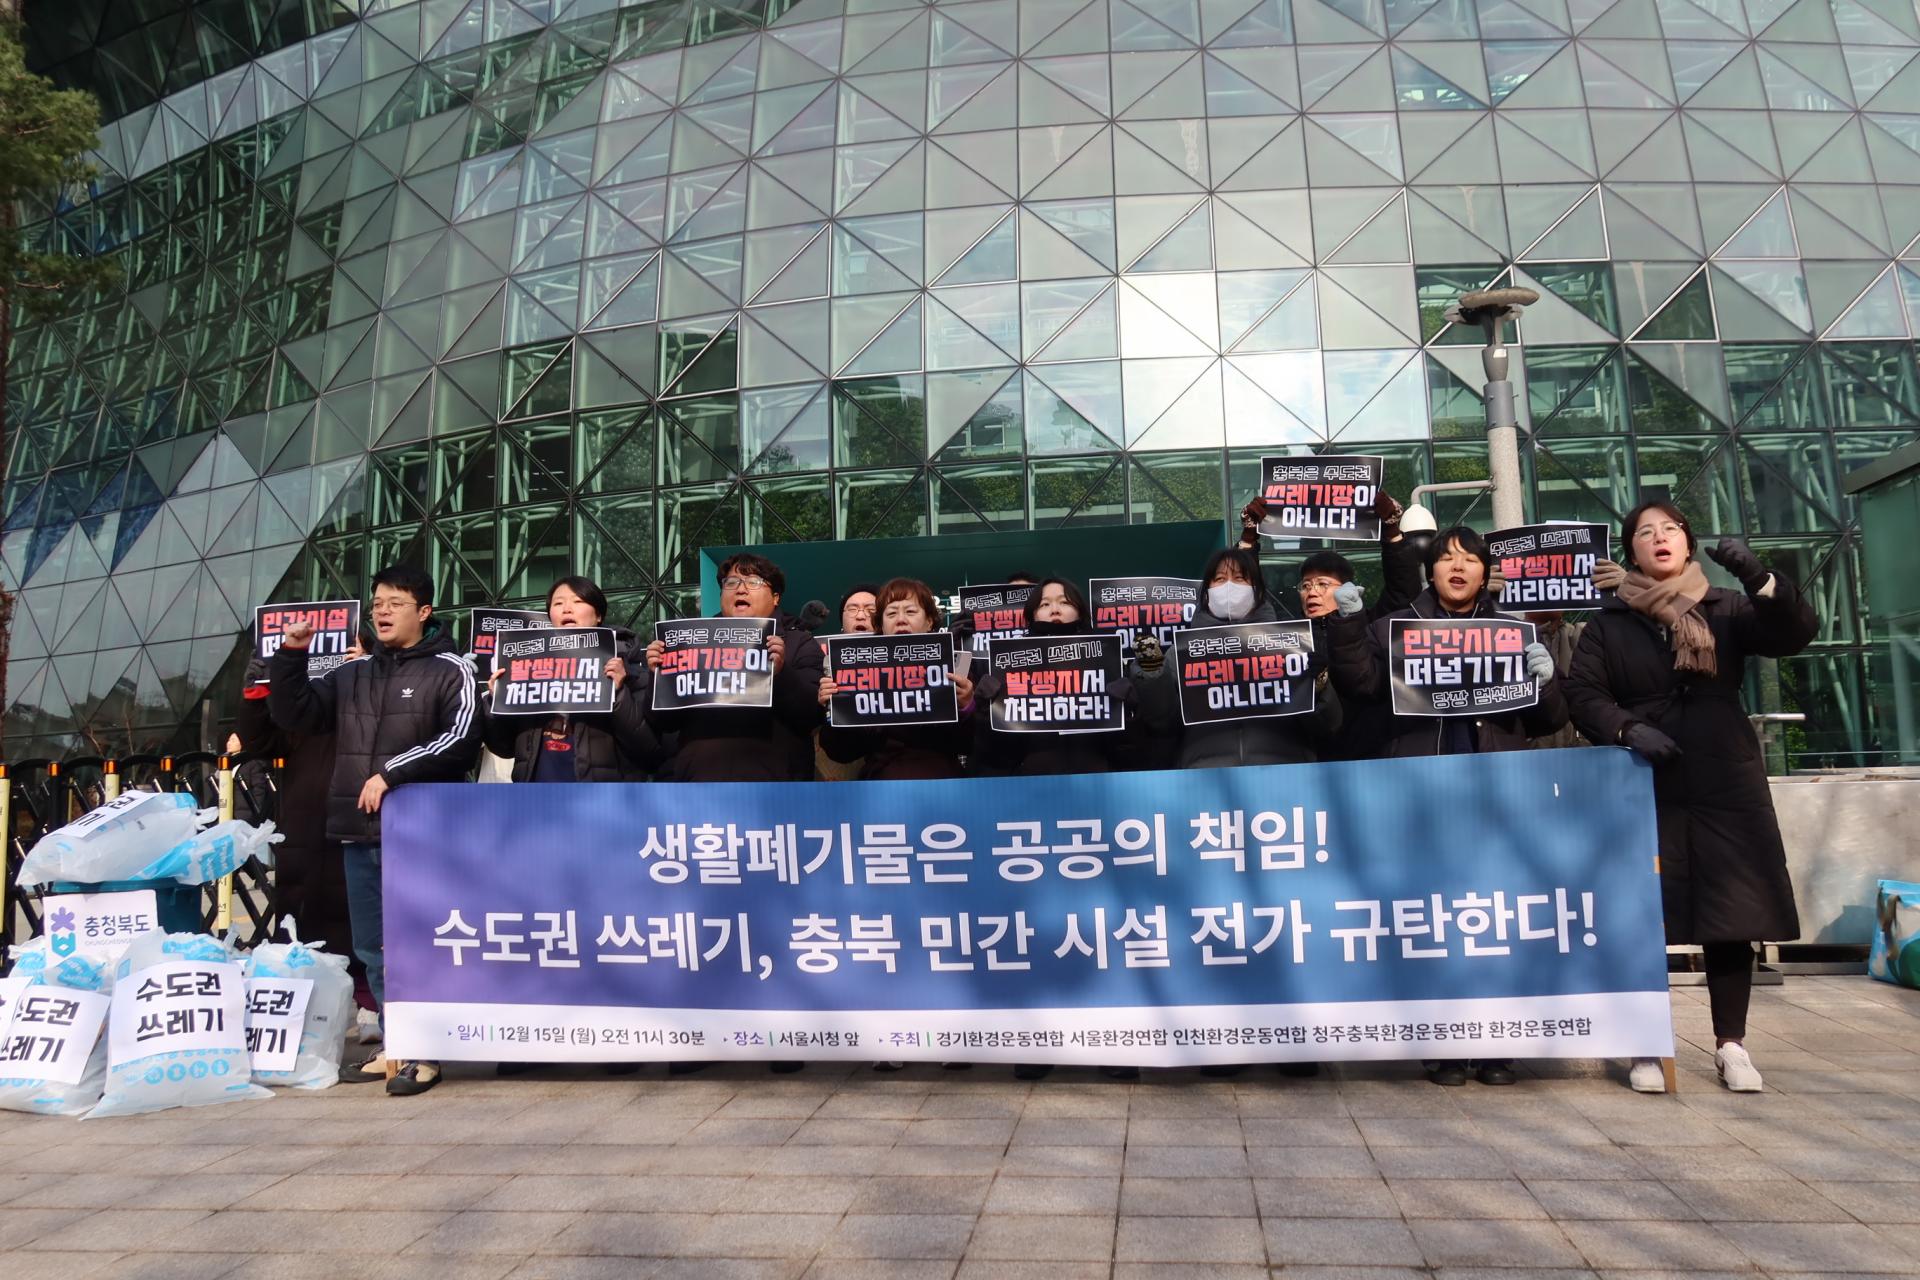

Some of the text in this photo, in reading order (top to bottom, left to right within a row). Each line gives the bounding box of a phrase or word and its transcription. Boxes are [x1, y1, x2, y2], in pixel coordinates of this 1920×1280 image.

[1273, 465, 1371, 481] 충북은 수도권
[1265, 484, 1376, 506] 쓰레기장이
[1282, 507, 1356, 529] 아니다!
[1490, 528, 1591, 557] 수도권 쓰레기!
[1501, 553, 1597, 578] 발생지서
[965, 592, 1003, 610] 수도권
[1101, 585, 1197, 603] 충북은 수도권
[482, 617, 523, 631] 충북은
[974, 609, 1026, 631] 발생지
[262, 631, 347, 658] 떠기기
[503, 637, 545, 657] 수도권
[549, 632, 600, 651] 쓰레기!
[665, 628, 763, 647] 충북은 수도권
[1188, 632, 1300, 657] 충북은 수도권
[1403, 628, 1523, 655] 민간시설
[660, 648, 768, 675] 쓰레기장이
[841, 646, 888, 664] 충북은
[894, 643, 941, 661] 수도권
[995, 648, 1042, 669] 수도권
[1047, 640, 1103, 663] 쓰레기!
[510, 658, 600, 681] 발생지서
[836, 664, 950, 691] 쓰레기장이
[1185, 652, 1309, 686] 쓰레기장이
[1404, 655, 1524, 685] 떠넘기기
[505, 681, 602, 705] 처리하라!
[676, 671, 746, 697] 아니다!
[1006, 669, 1105, 695] 발생지서
[1207, 680, 1290, 709] 아니다!
[855, 690, 931, 714] 아니다!
[1432, 682, 1533, 709] 당장 멈춰라!
[1003, 696, 1111, 721] 처리하라!
[639, 807, 1329, 885] 생활폐기물은 공공의 책임!
[84, 914, 150, 937] 충청북도
[433, 888, 1598, 980] 수도권 쓰레기, 충북 민간 시설 전가 규탄한다!
[136, 972, 222, 1002] 수도권
[137, 1008, 224, 1042] 쓰레기
[457, 1018, 1592, 1047] 일시 12월 15일 (월) 오전 11시 30분 장소 서울시청 앞 주최 경기환경운동연합 서울환경연합 인천환경운동연합 청주충북환경운동연합 환경운동연합
[246, 1028, 287, 1053] 레기
